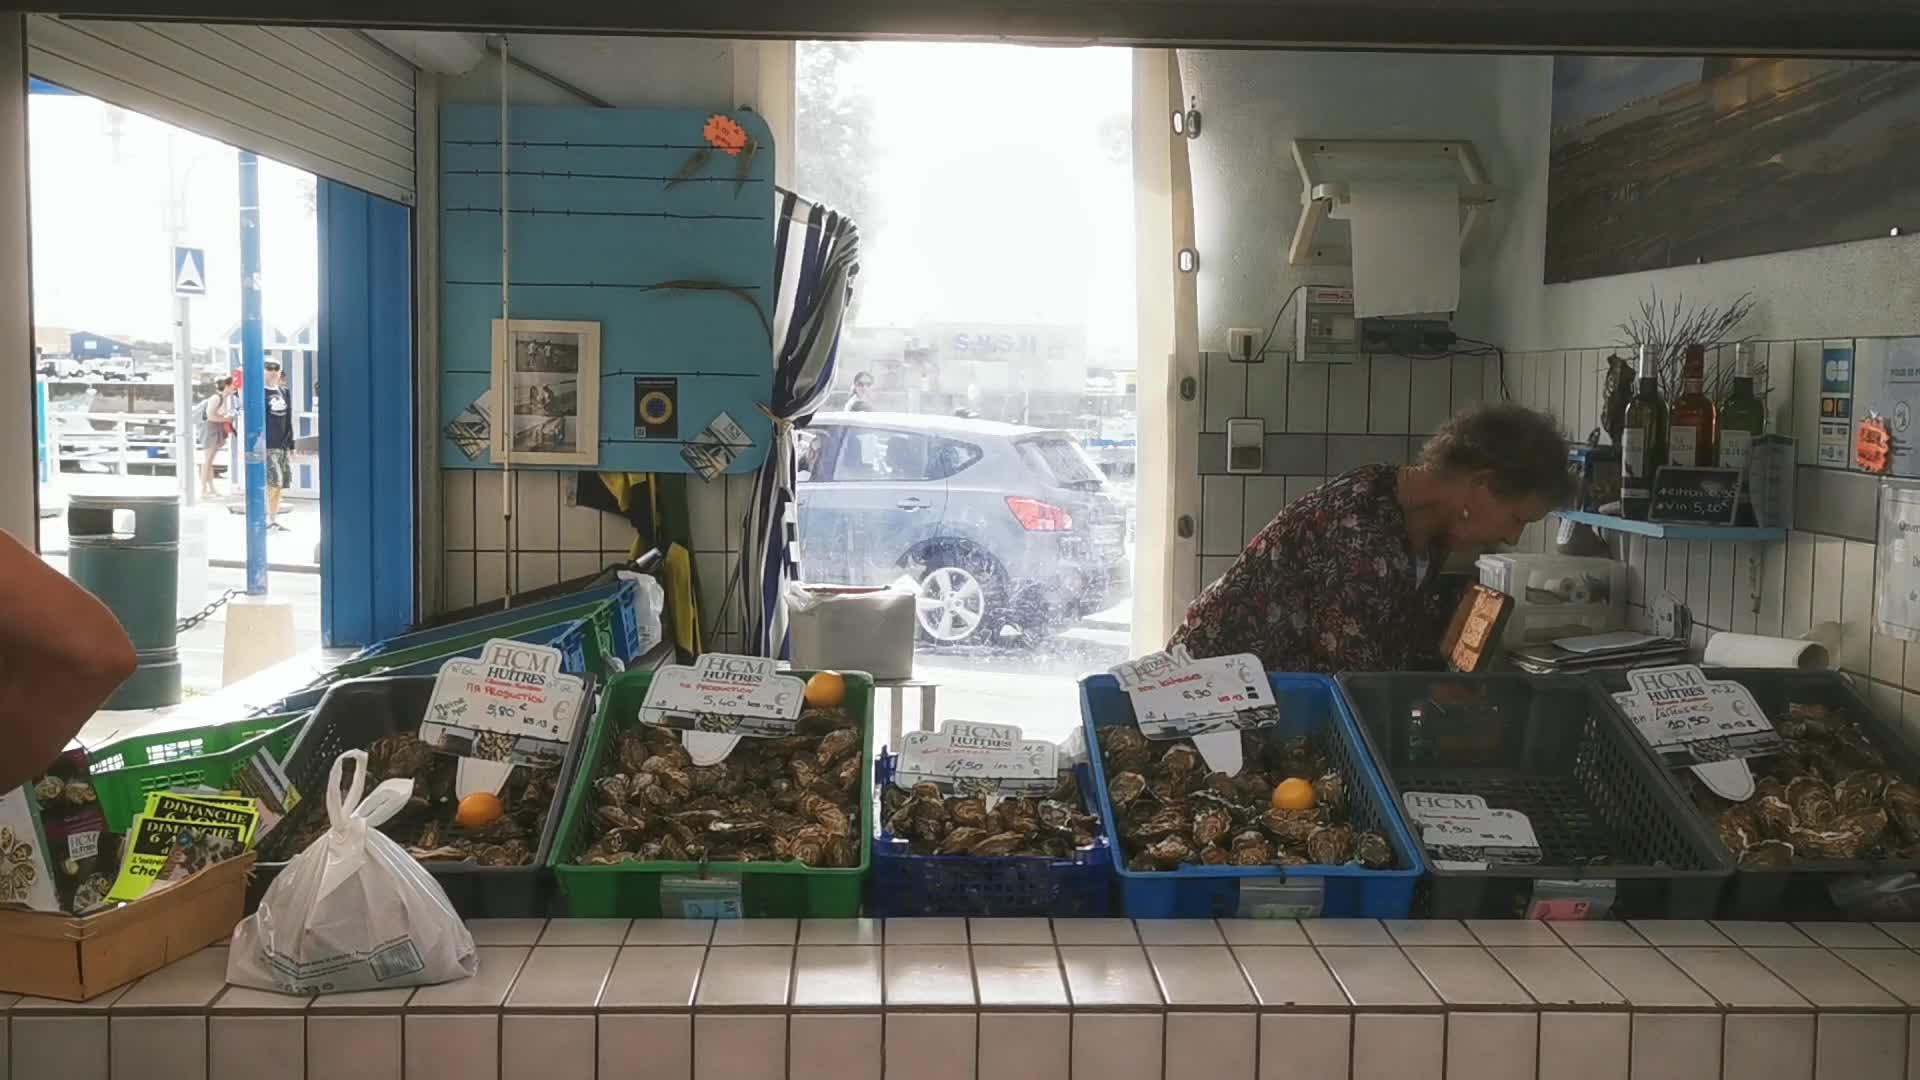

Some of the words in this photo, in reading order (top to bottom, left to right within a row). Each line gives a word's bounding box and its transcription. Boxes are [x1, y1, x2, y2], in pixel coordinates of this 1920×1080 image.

[492, 646, 551, 673] HCM
[707, 657, 765, 674] HCM
[1638, 670, 1698, 691] HCM
[952, 724, 1010, 740] HCM
[1414, 796, 1475, 810] HCM
[163, 800, 248, 824] DIMANCHE
[149, 834, 161, 843] 6
